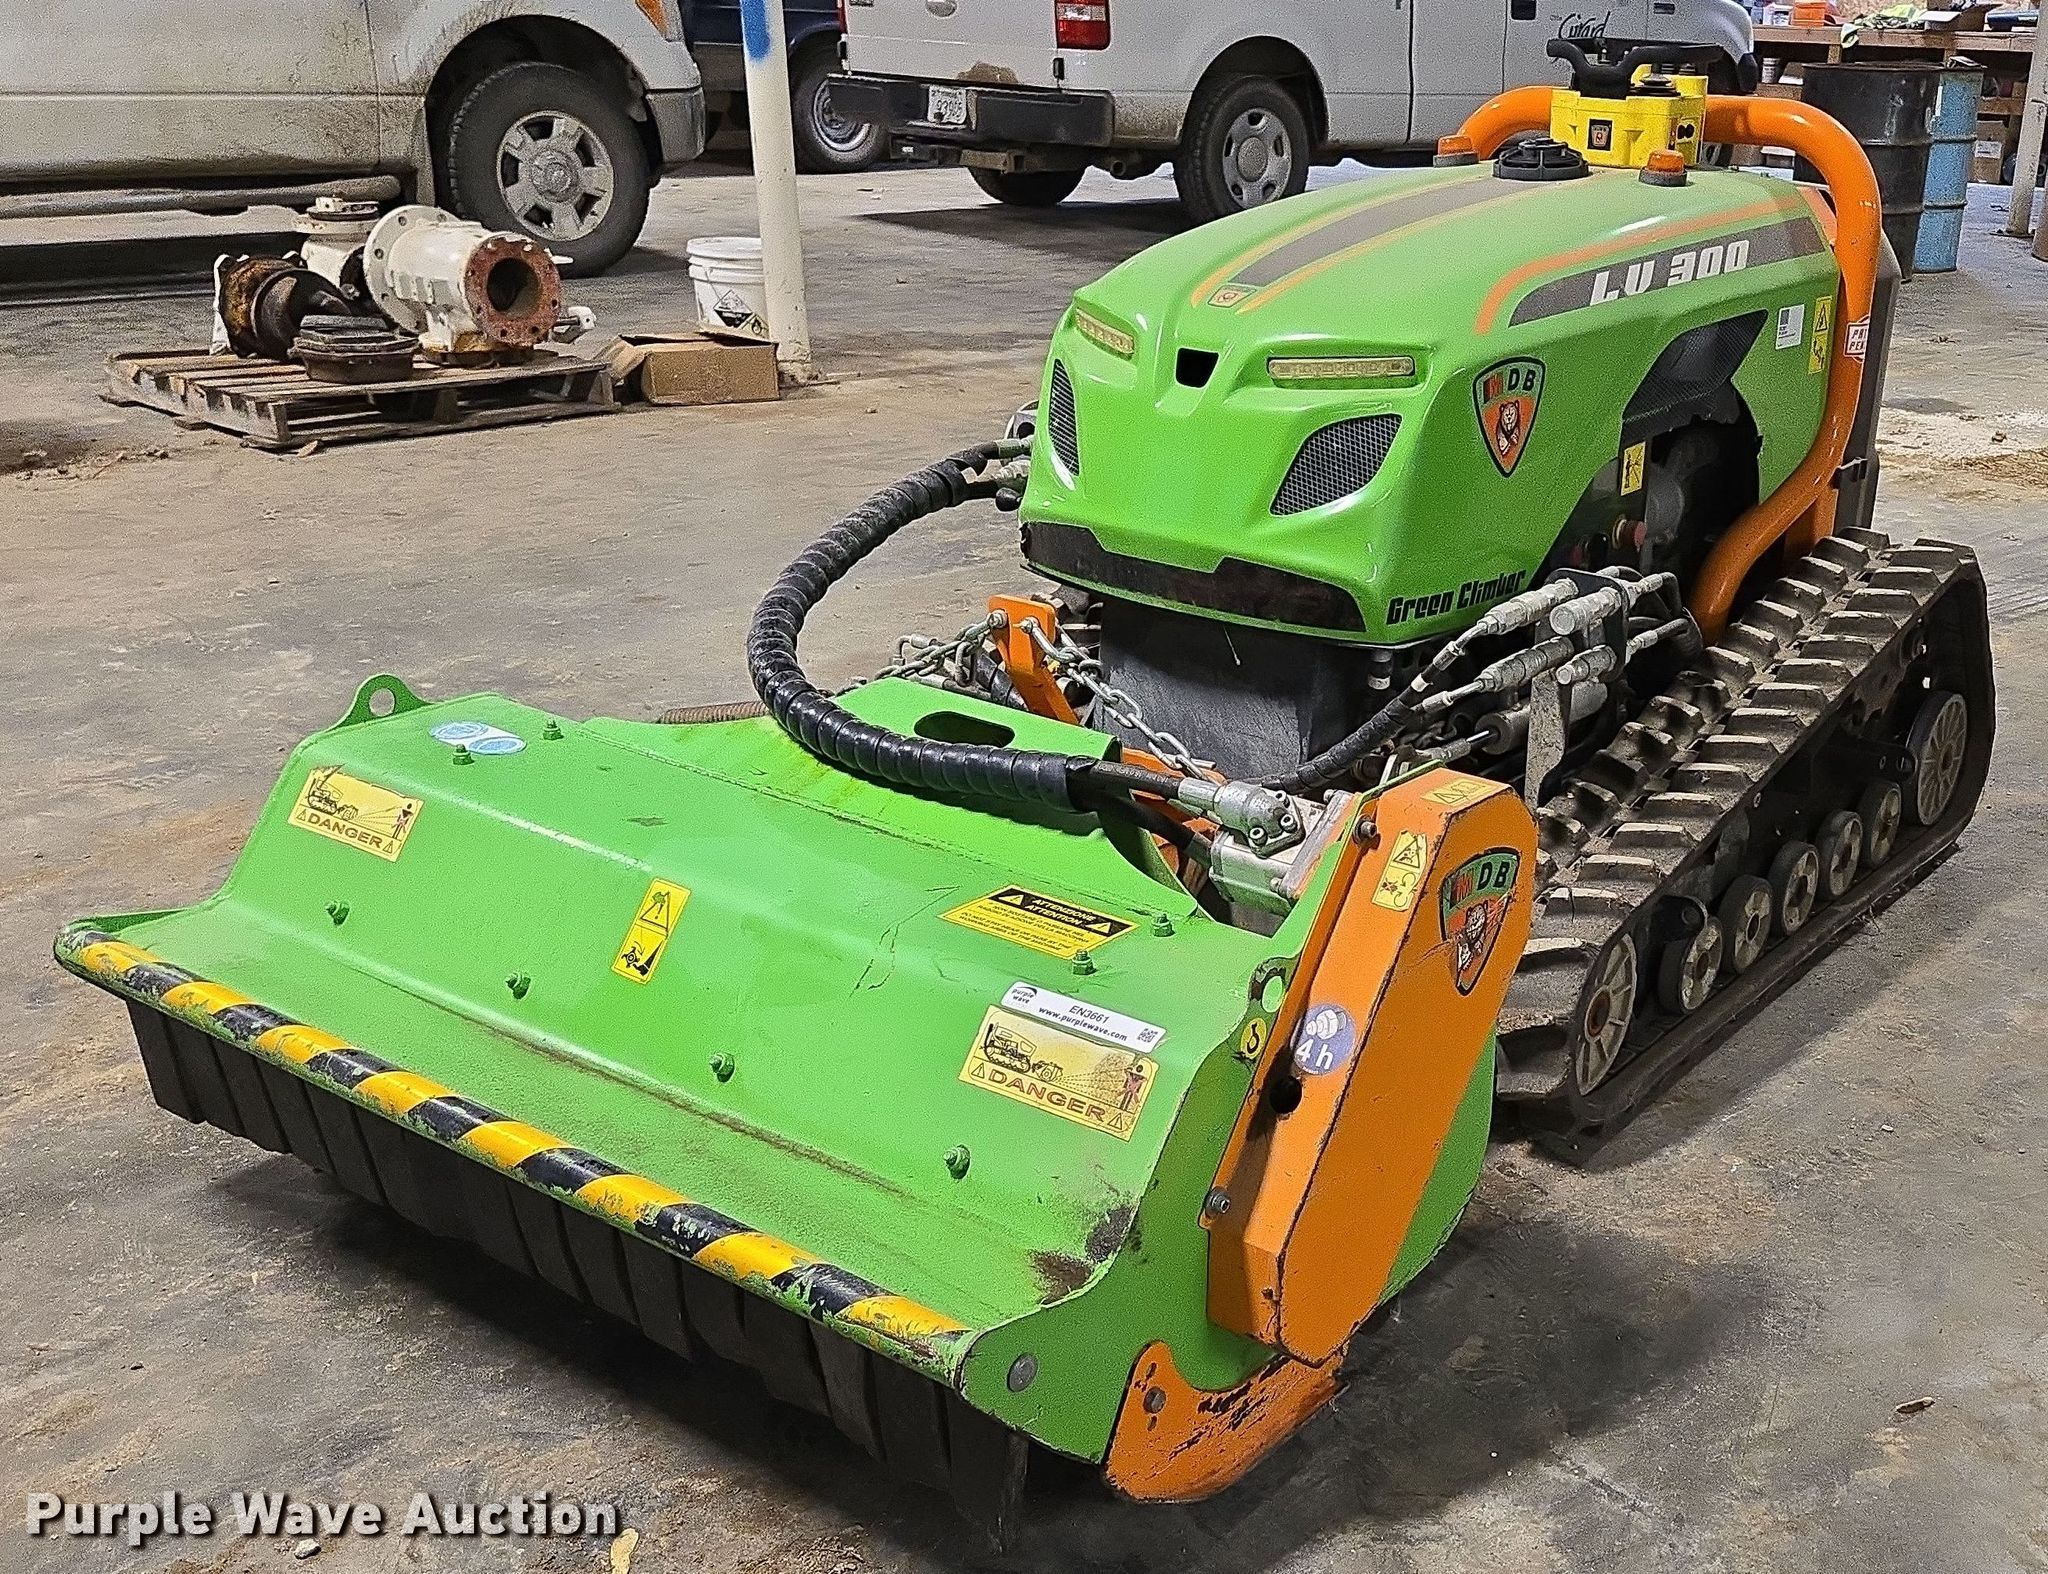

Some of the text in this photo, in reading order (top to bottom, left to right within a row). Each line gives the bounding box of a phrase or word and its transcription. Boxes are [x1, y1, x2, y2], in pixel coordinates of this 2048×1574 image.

[1667, 239, 1750, 287] 300
[1386, 569, 1526, 626] Green Climber
[307, 812, 383, 849] DANGER
[1024, 905, 1083, 924] ATTENTION
[1032, 898, 1097, 922] ATTENZIONE
[1011, 989, 1034, 998] purple
[1013, 995, 1030, 1004] wave
[1038, 1007, 1127, 1042] www.purplewave.com
[1069, 1005, 1110, 1024] EN3661
[1296, 1039, 1334, 1070] 4 h
[988, 1069, 1107, 1123] DANGER
